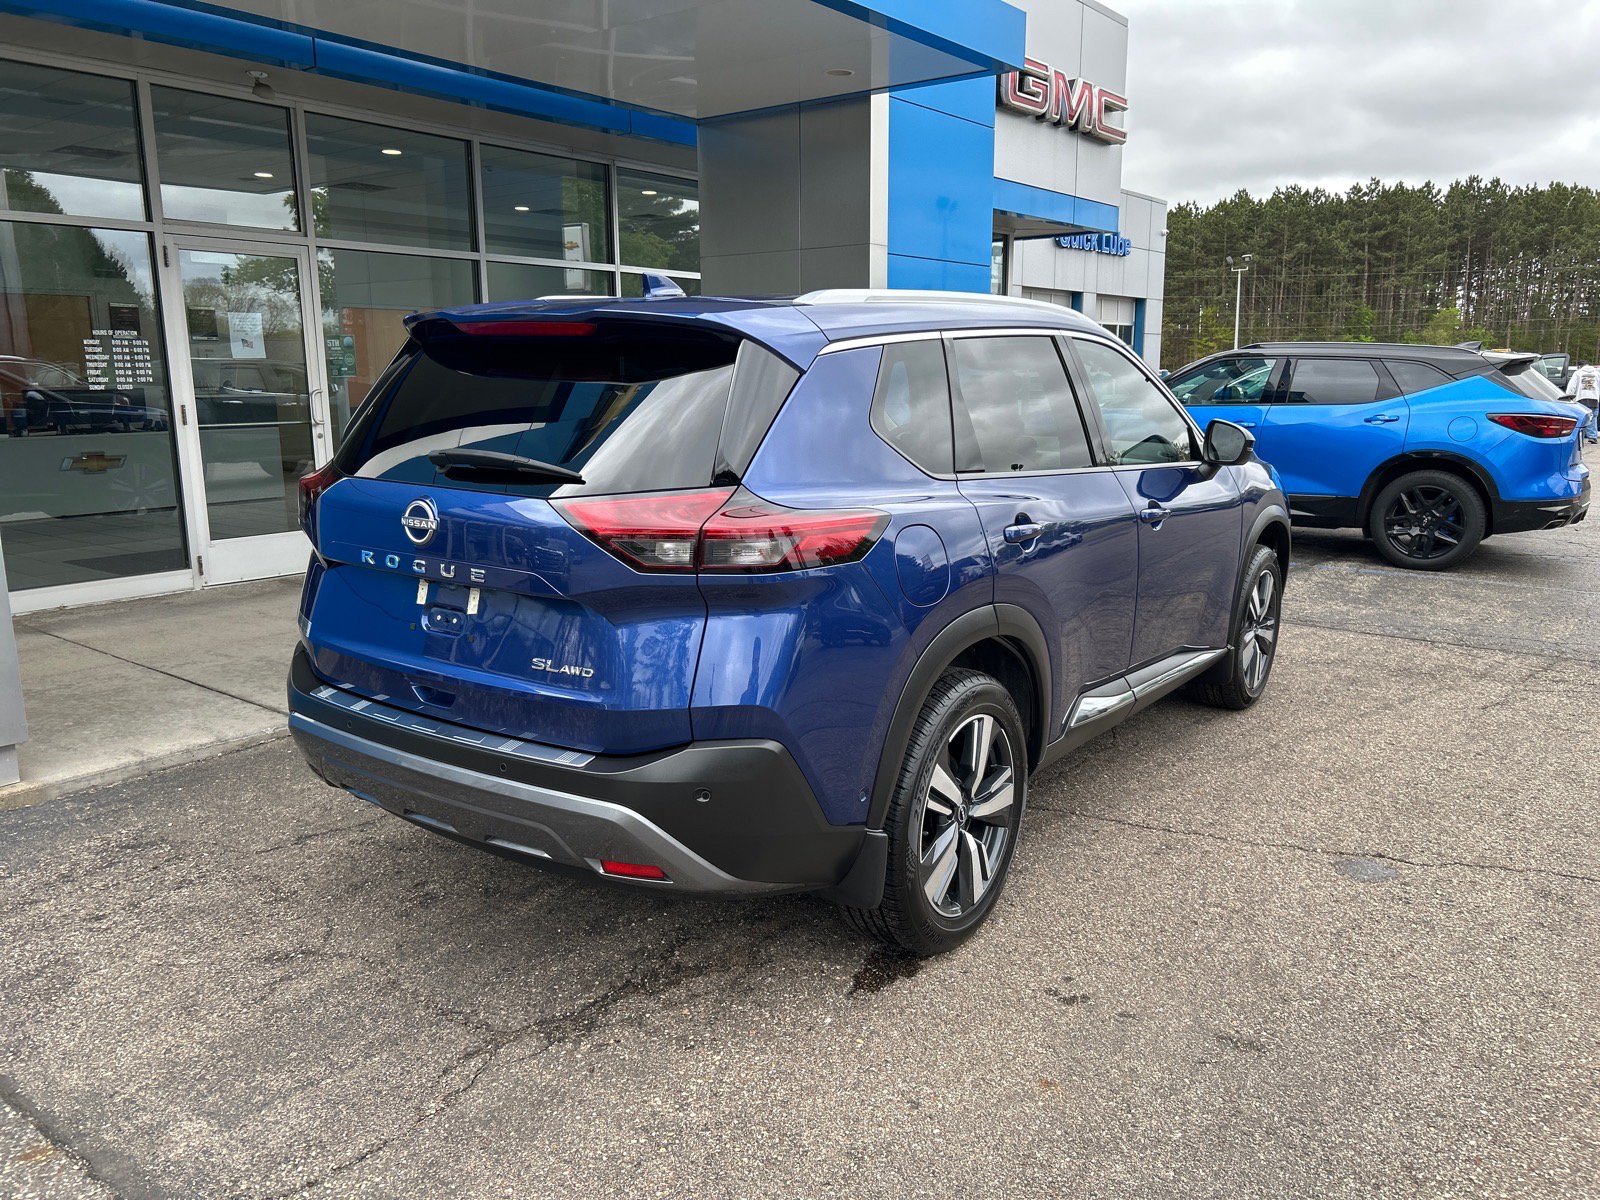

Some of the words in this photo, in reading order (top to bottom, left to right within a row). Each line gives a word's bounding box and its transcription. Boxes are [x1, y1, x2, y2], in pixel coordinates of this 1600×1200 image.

[1003, 55, 1128, 145] GMC
[402, 517, 436, 529] NISSAN
[361, 550, 486, 583] ROGUE
[531, 657, 559, 672] SL
[559, 664, 594, 678] AWD
